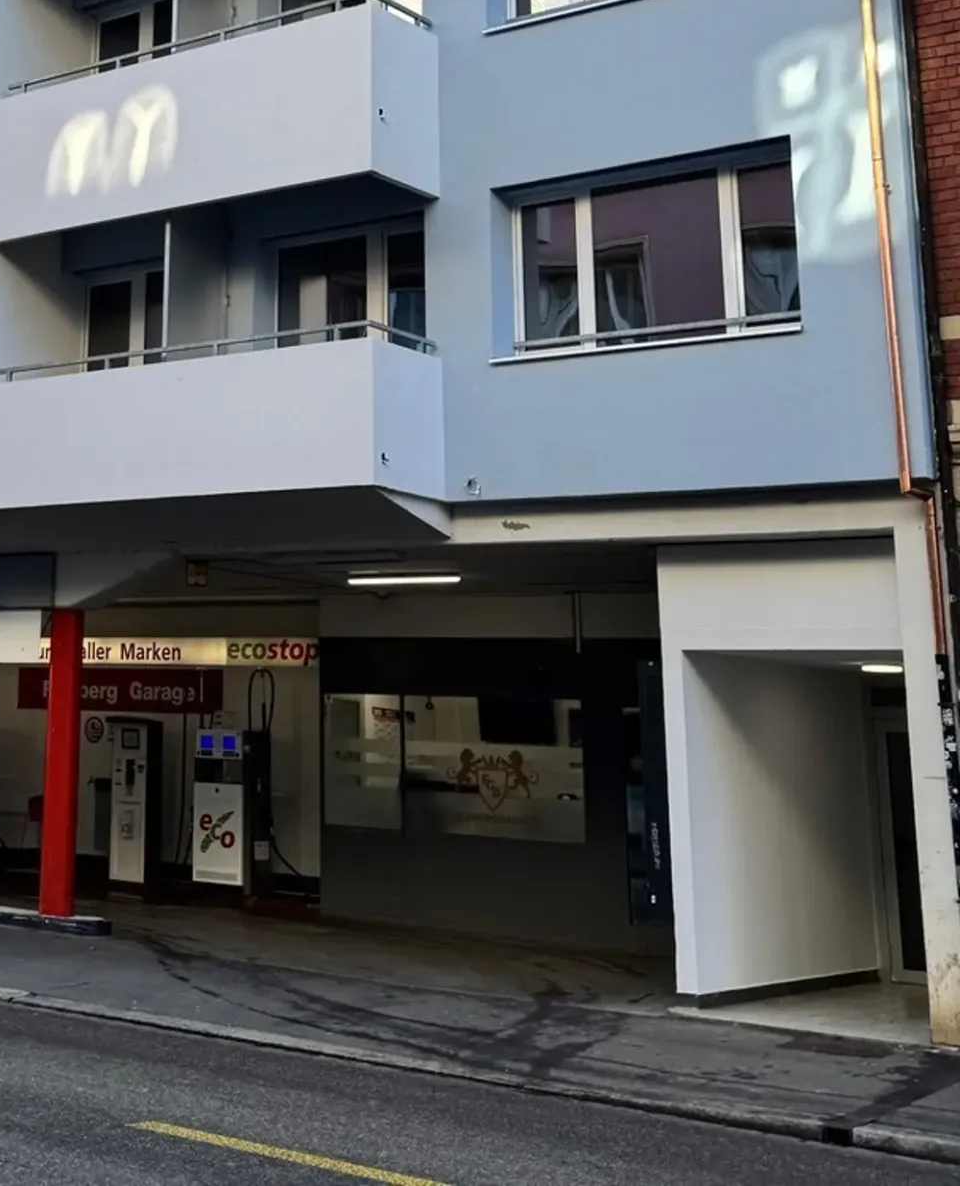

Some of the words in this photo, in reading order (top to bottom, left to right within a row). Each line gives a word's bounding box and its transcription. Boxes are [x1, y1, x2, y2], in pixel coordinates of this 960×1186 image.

[81, 642, 111, 660] aller
[121, 642, 181, 661] Marken
[227, 639, 320, 665] ecostop
[42, 680, 119, 705] Fberg
[129, 680, 196, 706] Garage
[199, 813, 235, 848] eco
